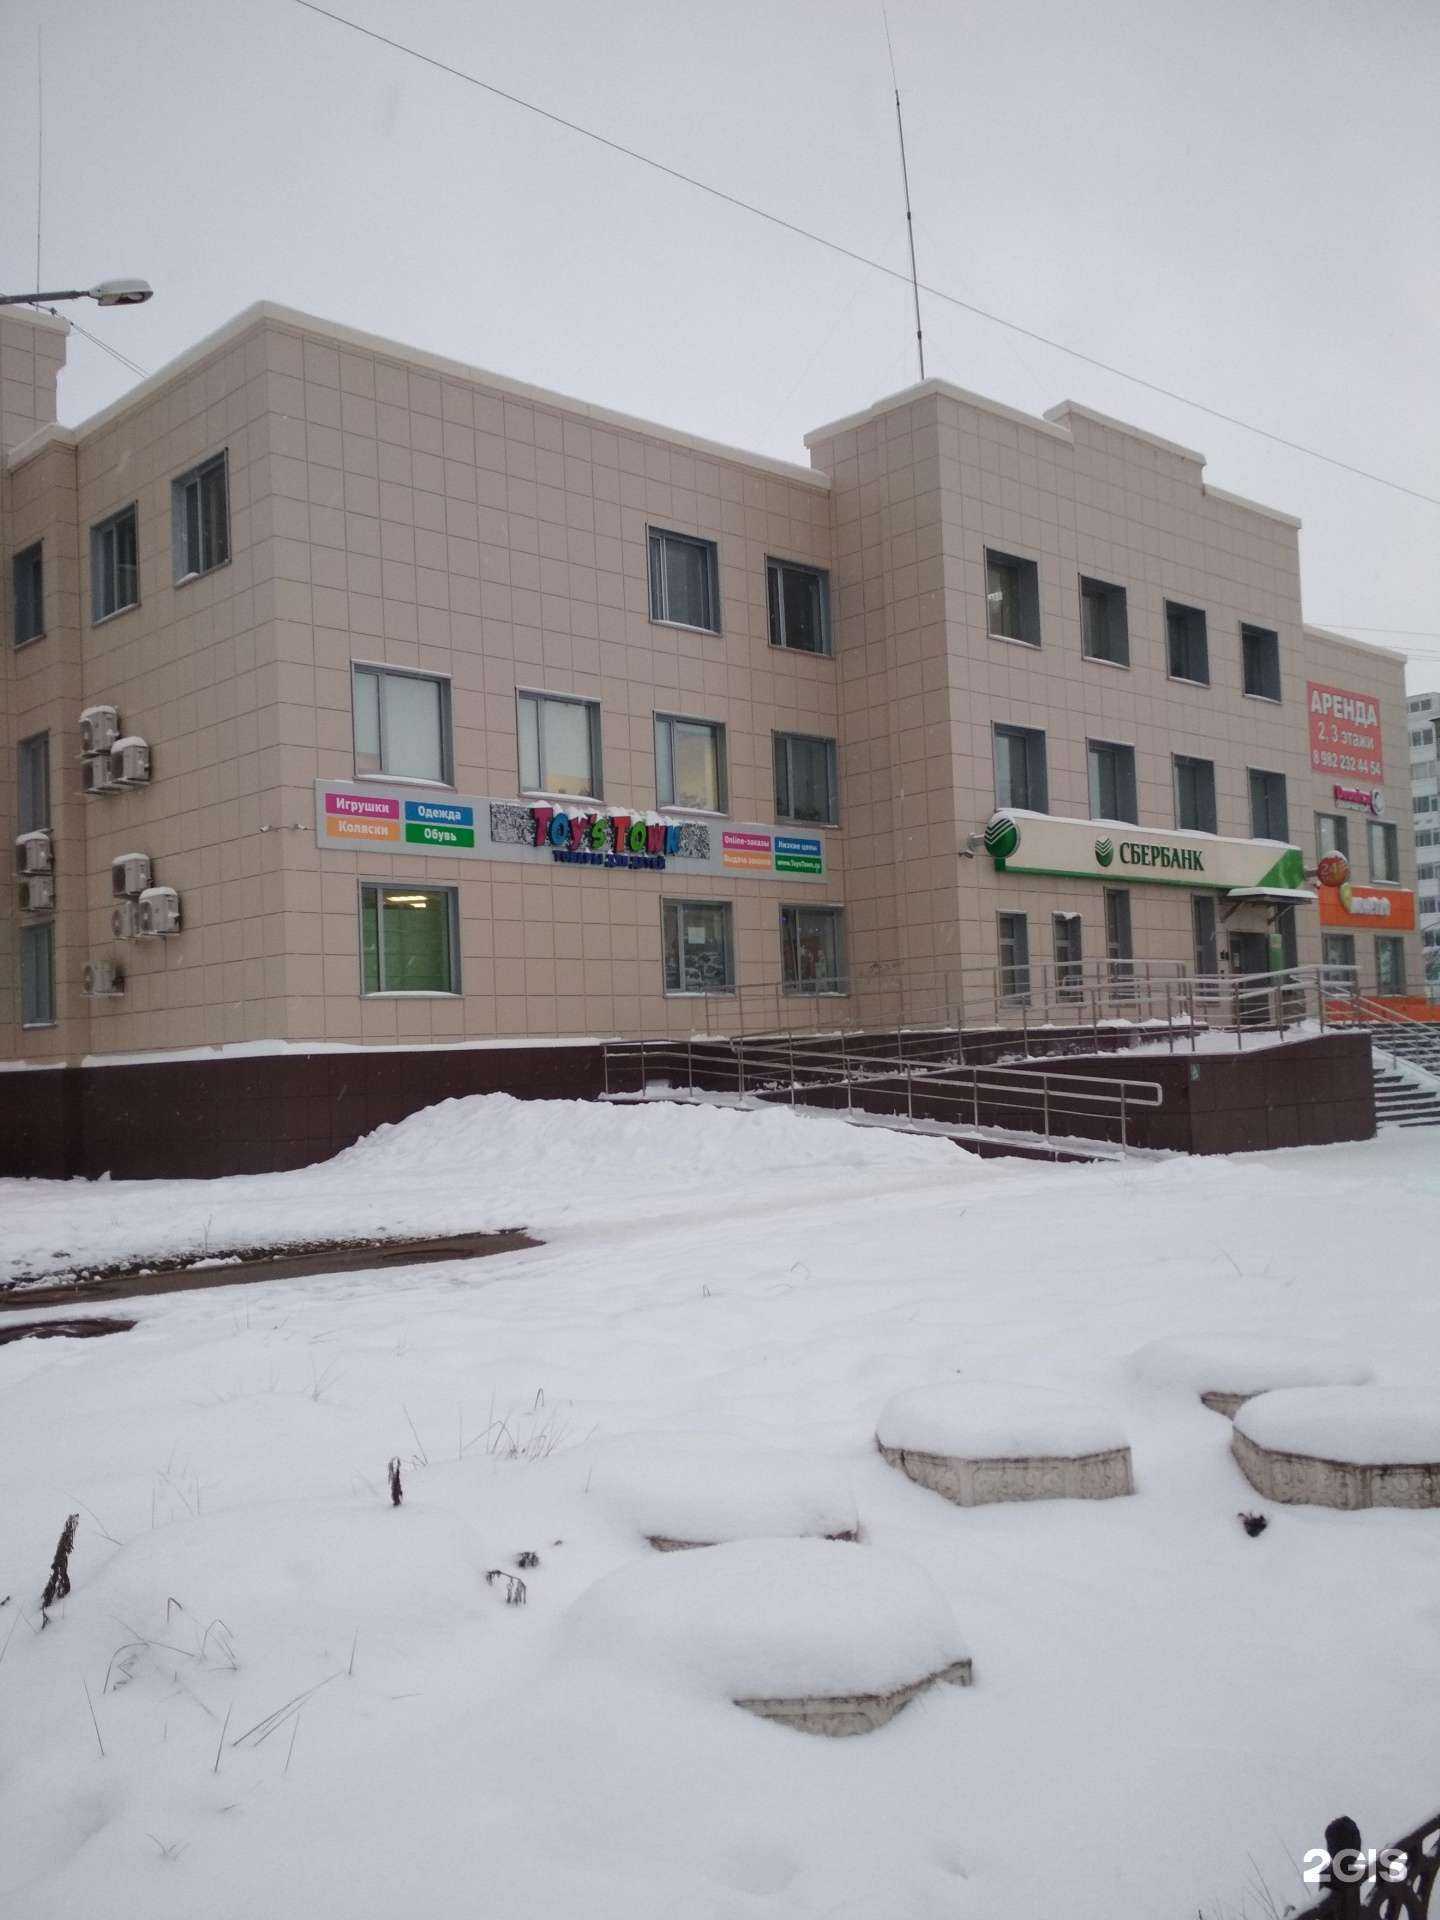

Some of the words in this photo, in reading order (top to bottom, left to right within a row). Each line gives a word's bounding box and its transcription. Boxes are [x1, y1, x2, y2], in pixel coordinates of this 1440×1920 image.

[1311, 690, 1377, 728] АРЕНДА
[1312, 749, 1320, 764] 8
[336, 797, 390, 814] Игрушки
[417, 805, 462, 821] Одежда
[338, 820, 389, 836] Коляски
[424, 827, 457, 842] Обувь
[1119, 842, 1204, 871] СБЕРБАНК
